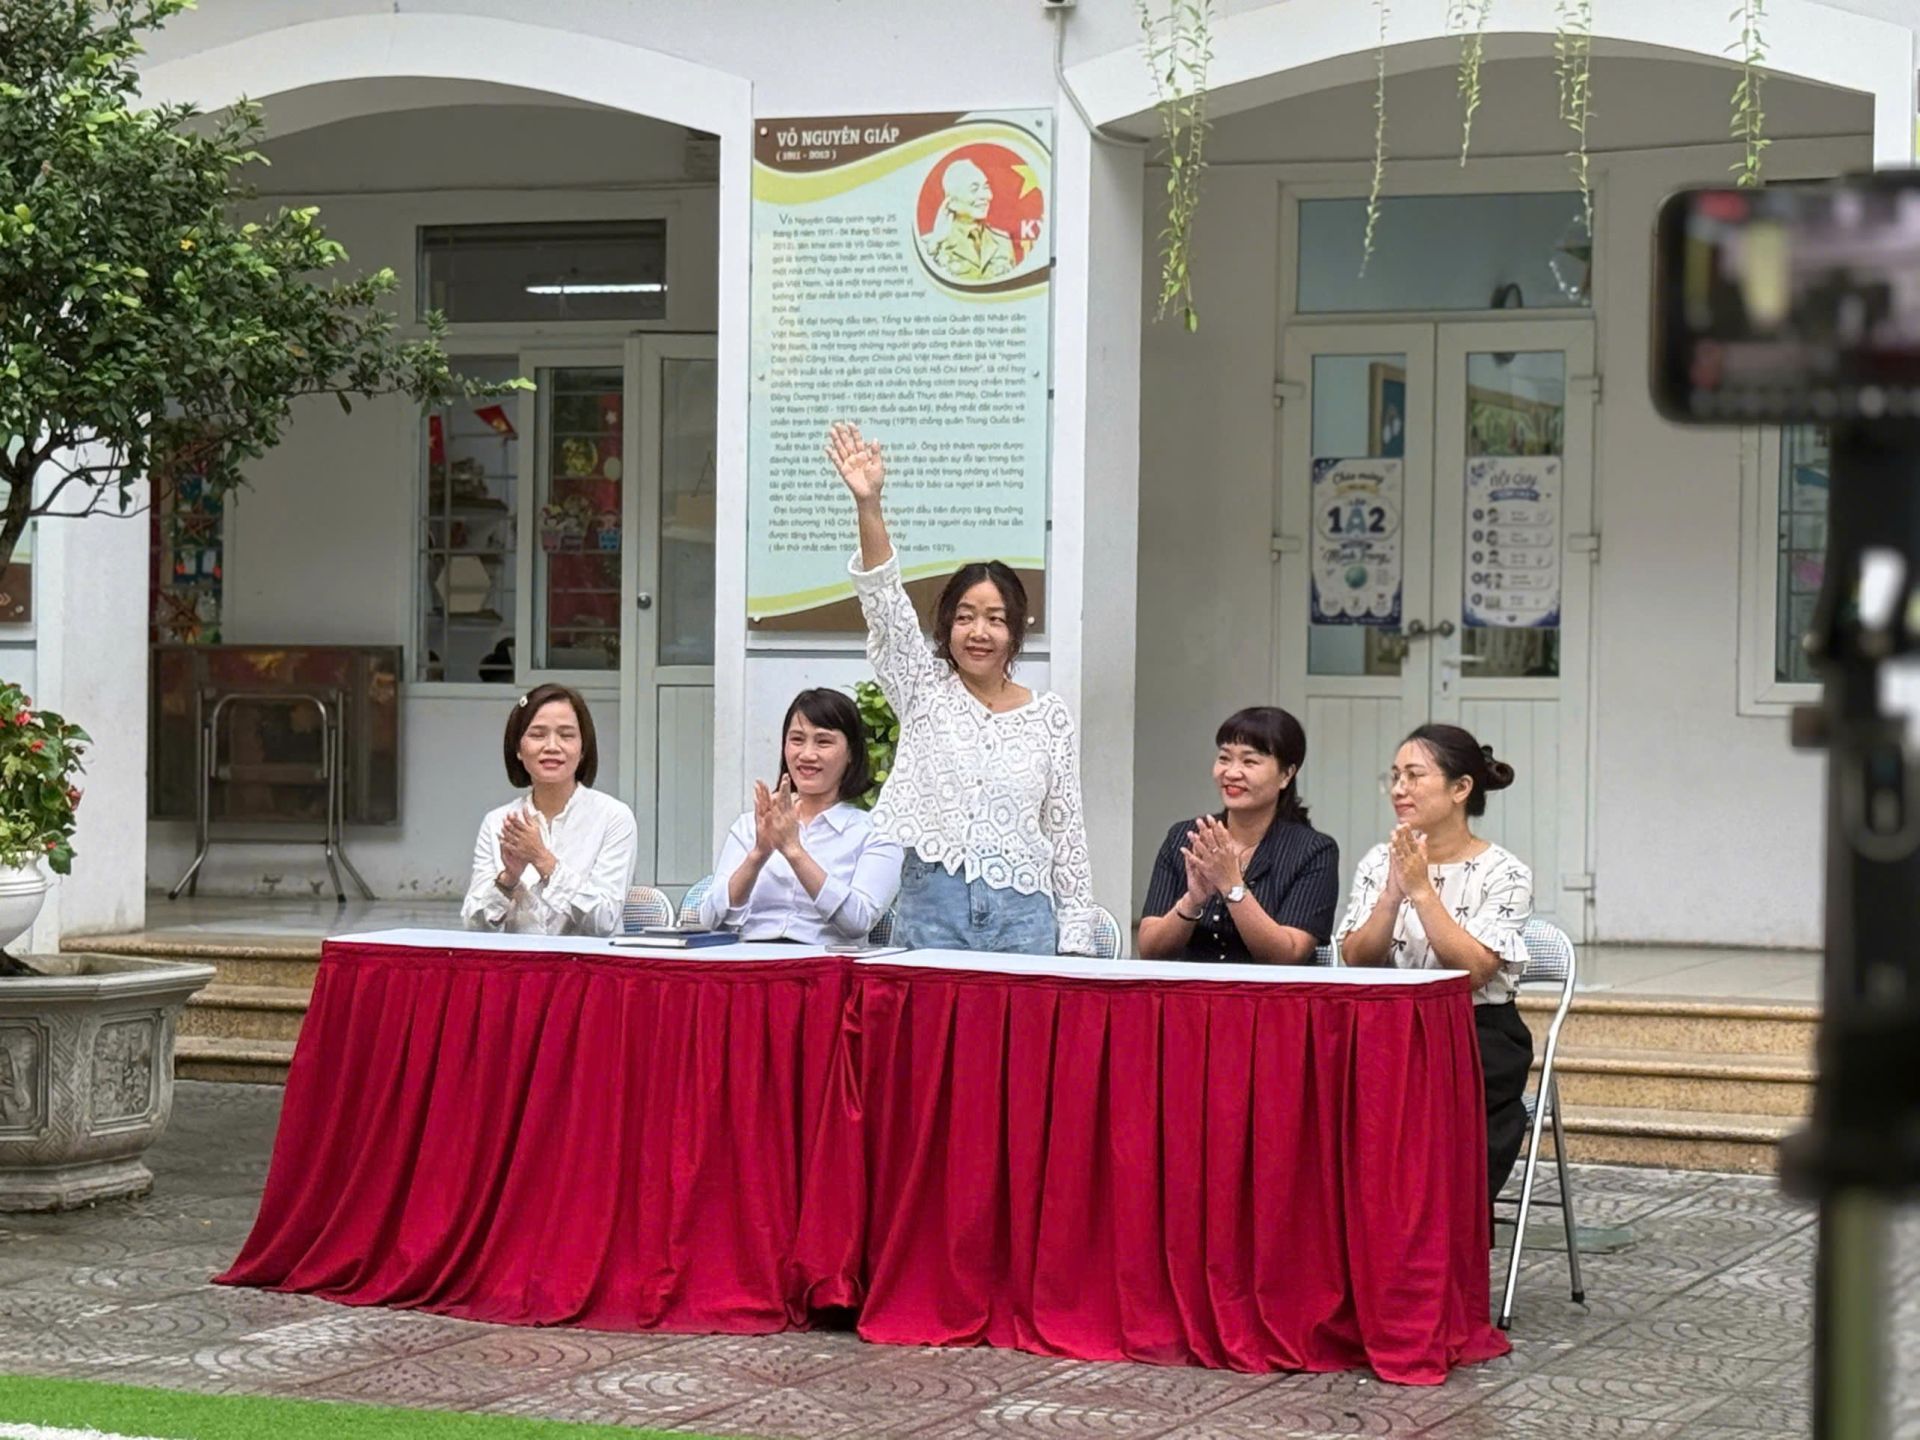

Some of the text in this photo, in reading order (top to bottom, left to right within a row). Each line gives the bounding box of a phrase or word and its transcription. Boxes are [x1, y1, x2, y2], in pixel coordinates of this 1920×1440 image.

[801, 125, 860, 146] NGUYÊN
[864, 122, 900, 144] GIÁP
[1327, 506, 1386, 534] 1A2
